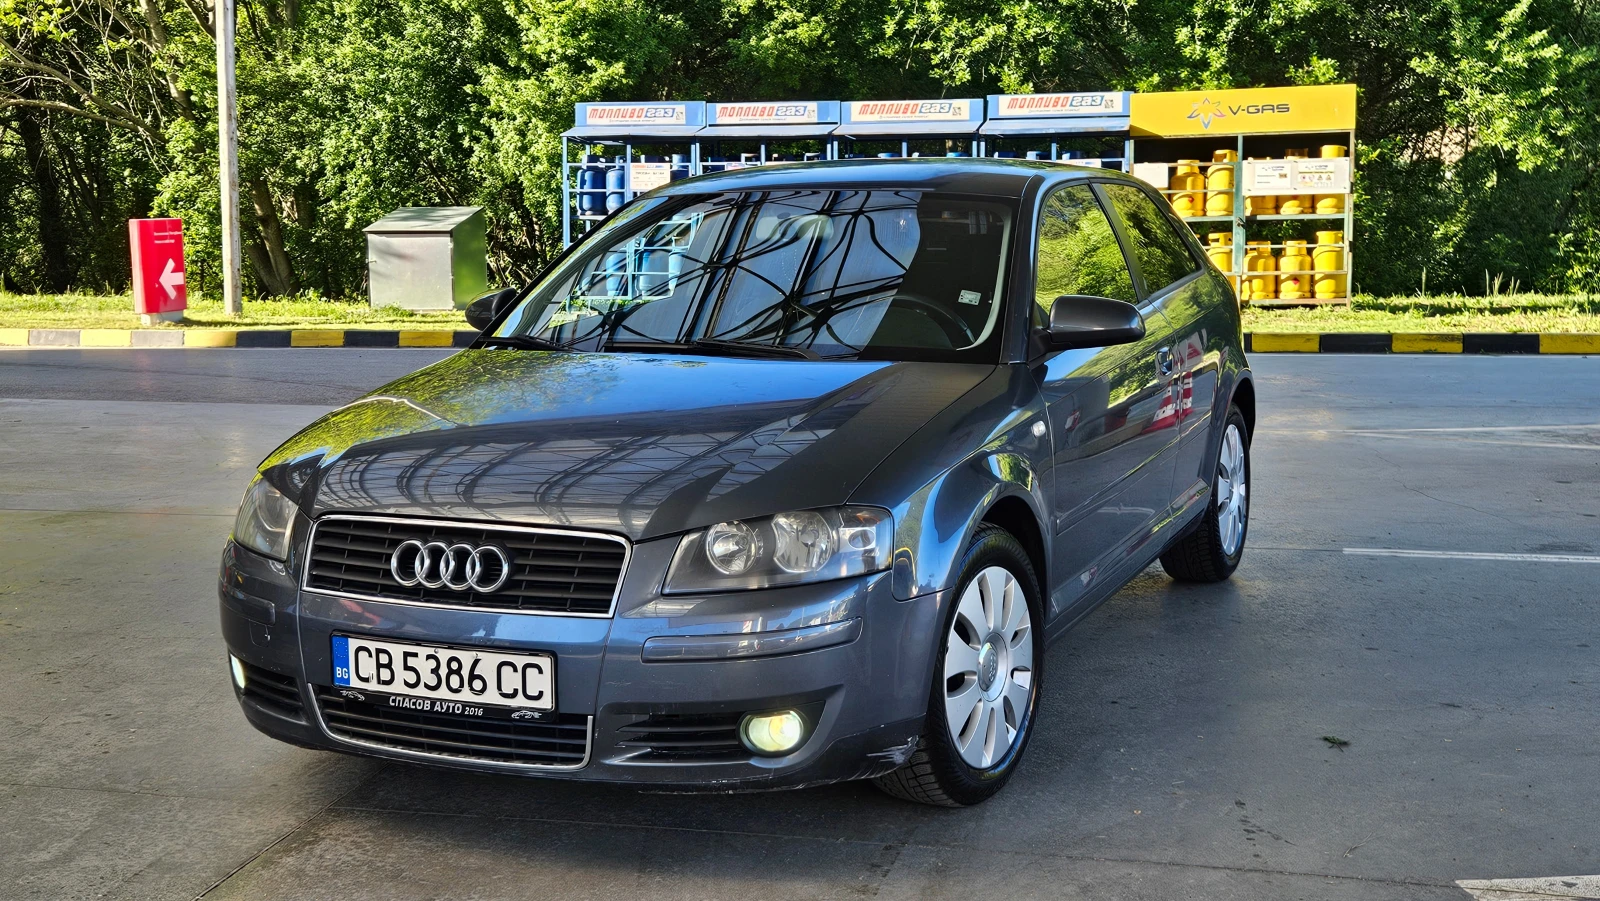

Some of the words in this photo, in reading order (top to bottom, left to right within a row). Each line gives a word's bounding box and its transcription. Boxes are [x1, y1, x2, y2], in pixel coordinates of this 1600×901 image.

[1228, 103, 1290, 116] V-GAS
[335, 666, 349, 679] BG
[402, 650, 488, 696] 5386
[389, 695, 431, 711] СПАСОВ
[433, 701, 463, 714] АУТО
[464, 706, 484, 716] 2016
